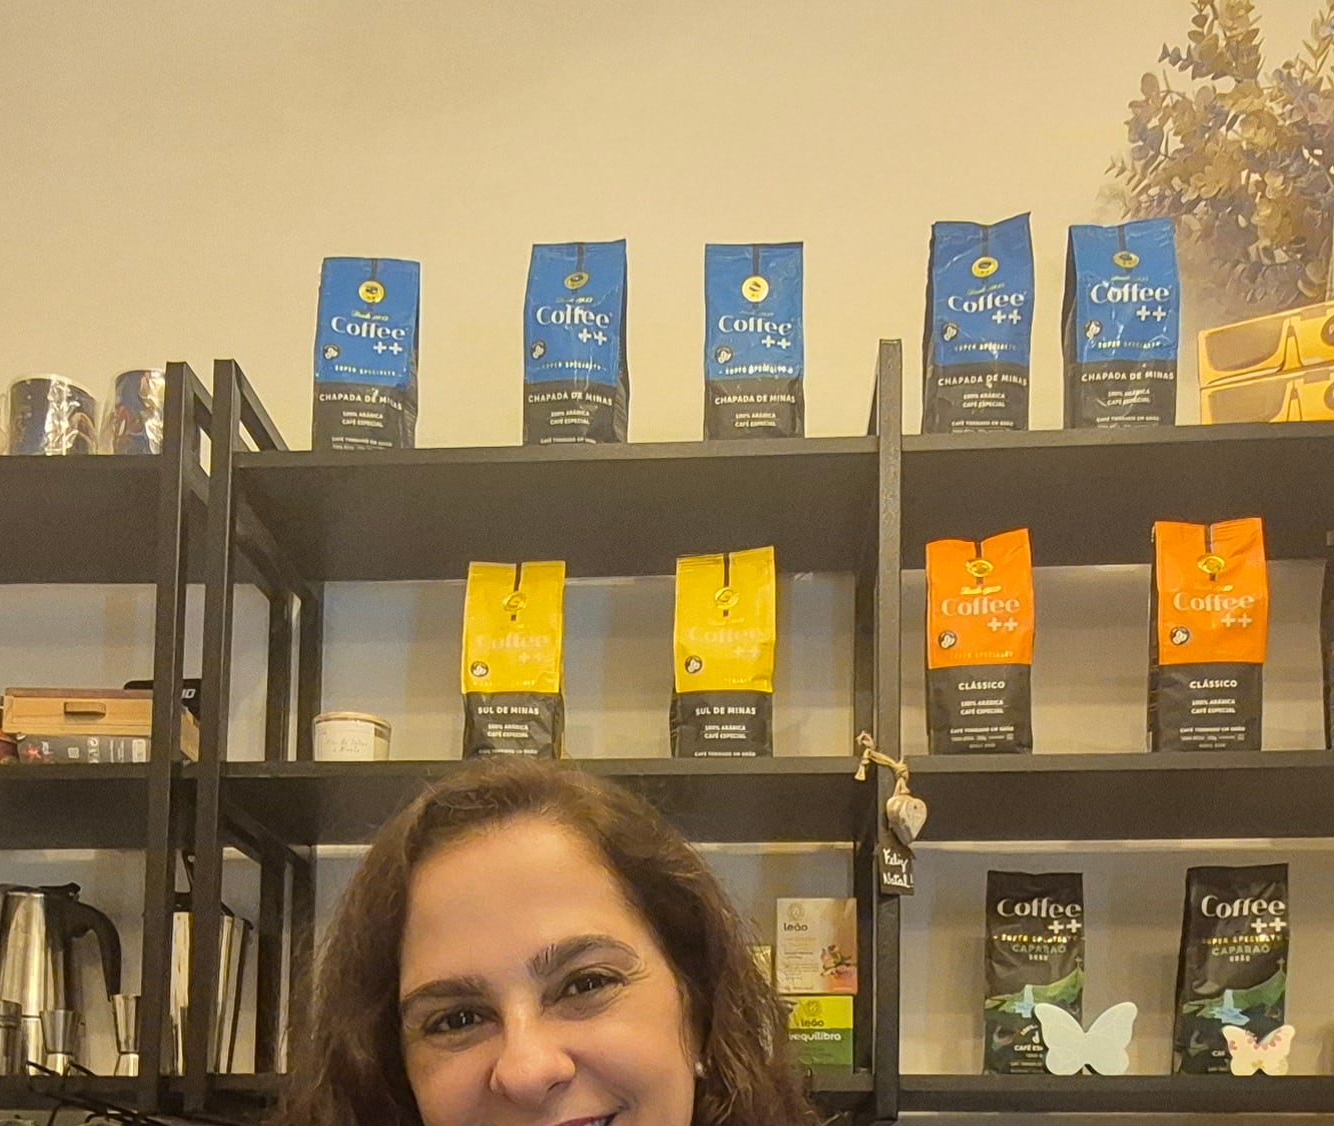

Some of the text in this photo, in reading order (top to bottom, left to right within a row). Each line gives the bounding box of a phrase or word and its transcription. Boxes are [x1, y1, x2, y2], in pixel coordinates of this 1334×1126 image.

[1090, 281, 1170, 304] Coffee
[947, 292, 1025, 313] Coffee
[536, 304, 610, 328] Coffee
[331, 316, 406, 341] Coffee
[718, 315, 792, 335] Coffee
[938, 374, 1027, 387] CHAPADA DE MINAS
[1081, 370, 1174, 382] CHAPADA DE MINAS
[319, 393, 362, 402] CHAPADA
[528, 391, 568, 403] CHAPADA
[585, 393, 613, 406] MINAS
[714, 394, 796, 405] CHAPADA DE MINAS
[941, 596, 1020, 616] Coffee
[1173, 592, 1255, 612] Coffee
[958, 680, 1006, 691] CLÁSSICO
[1189, 679, 1238, 689] CLÁSSICO
[478, 706, 539, 715] SUL DE MINAS
[695, 707, 756, 716] SUL DE MINAS
[997, 897, 1082, 919] Coffee
[1201, 895, 1286, 918] Coffee
[783, 922, 808, 932] leão
[801, 1018, 825, 1027] leão
